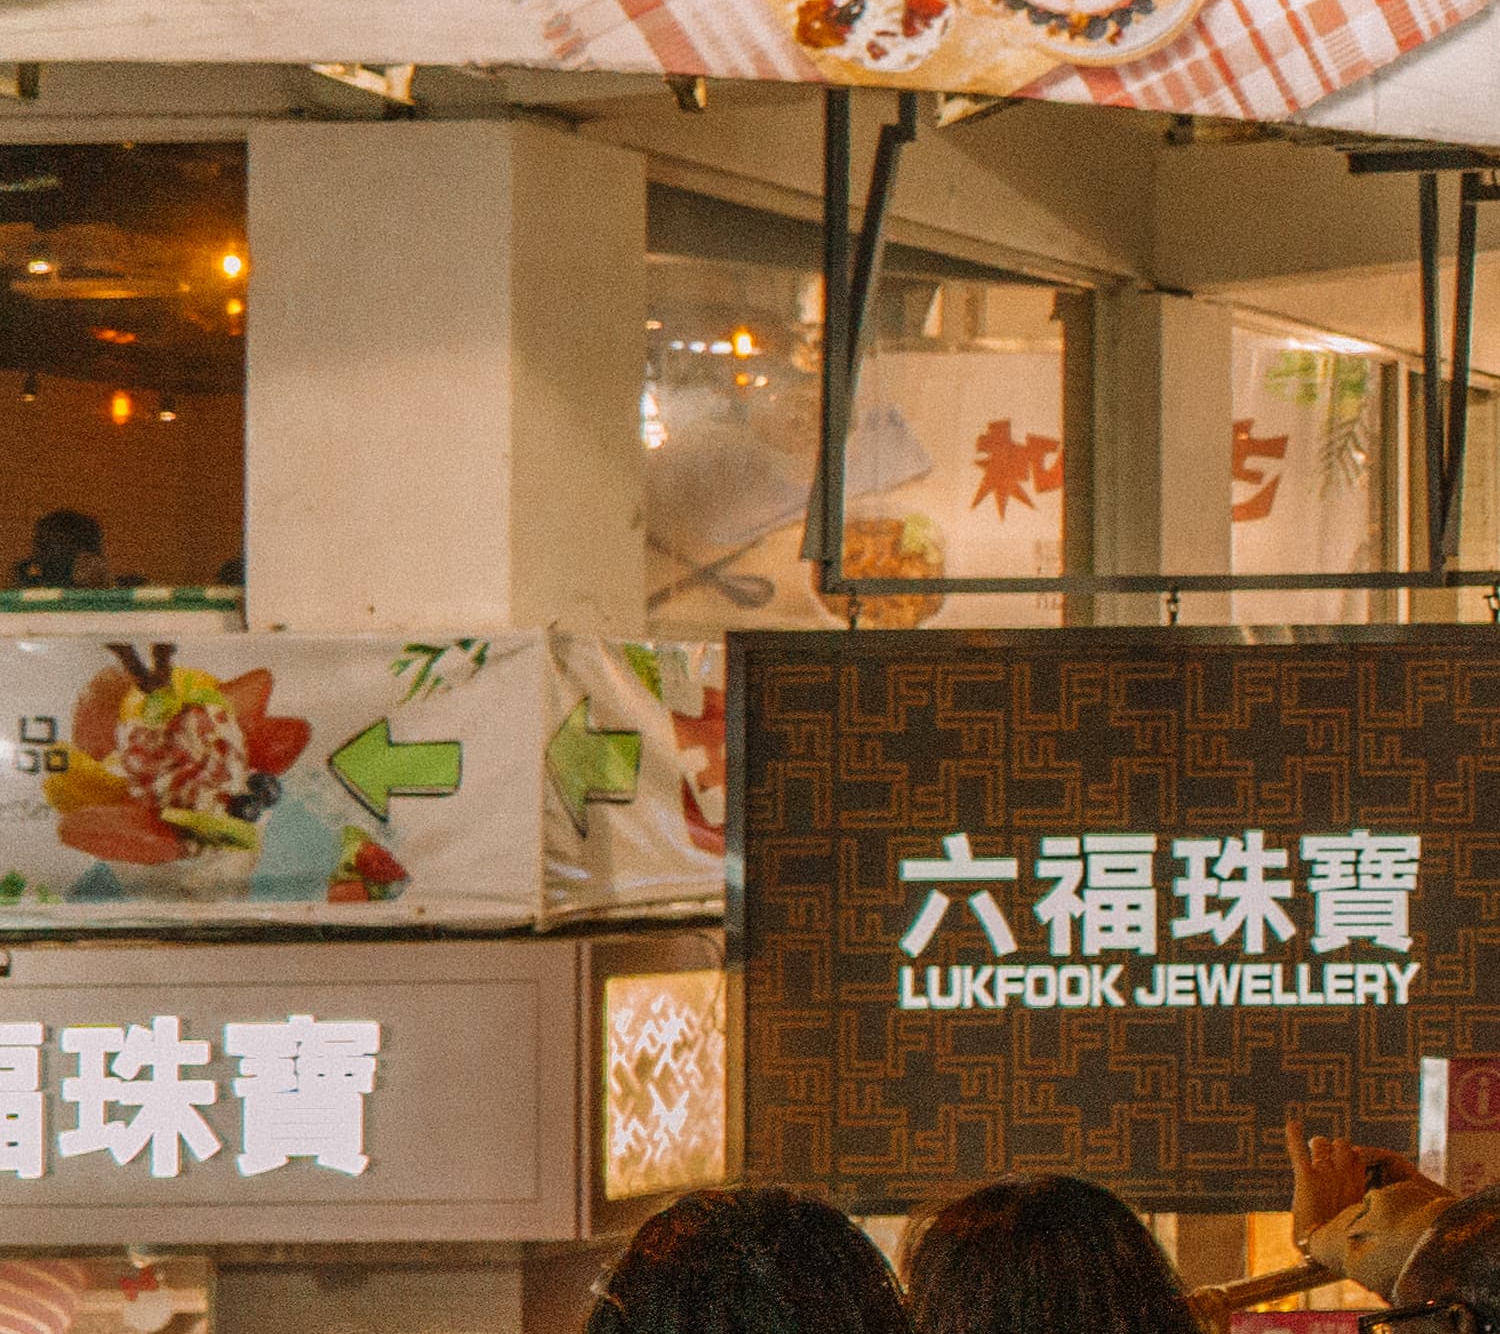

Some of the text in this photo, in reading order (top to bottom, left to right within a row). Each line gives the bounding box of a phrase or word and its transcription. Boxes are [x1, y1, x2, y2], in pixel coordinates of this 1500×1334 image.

[898, 829, 1421, 959] 六福珠寶
[900, 962, 1420, 1011] LUKFOOK JEWELLERY
